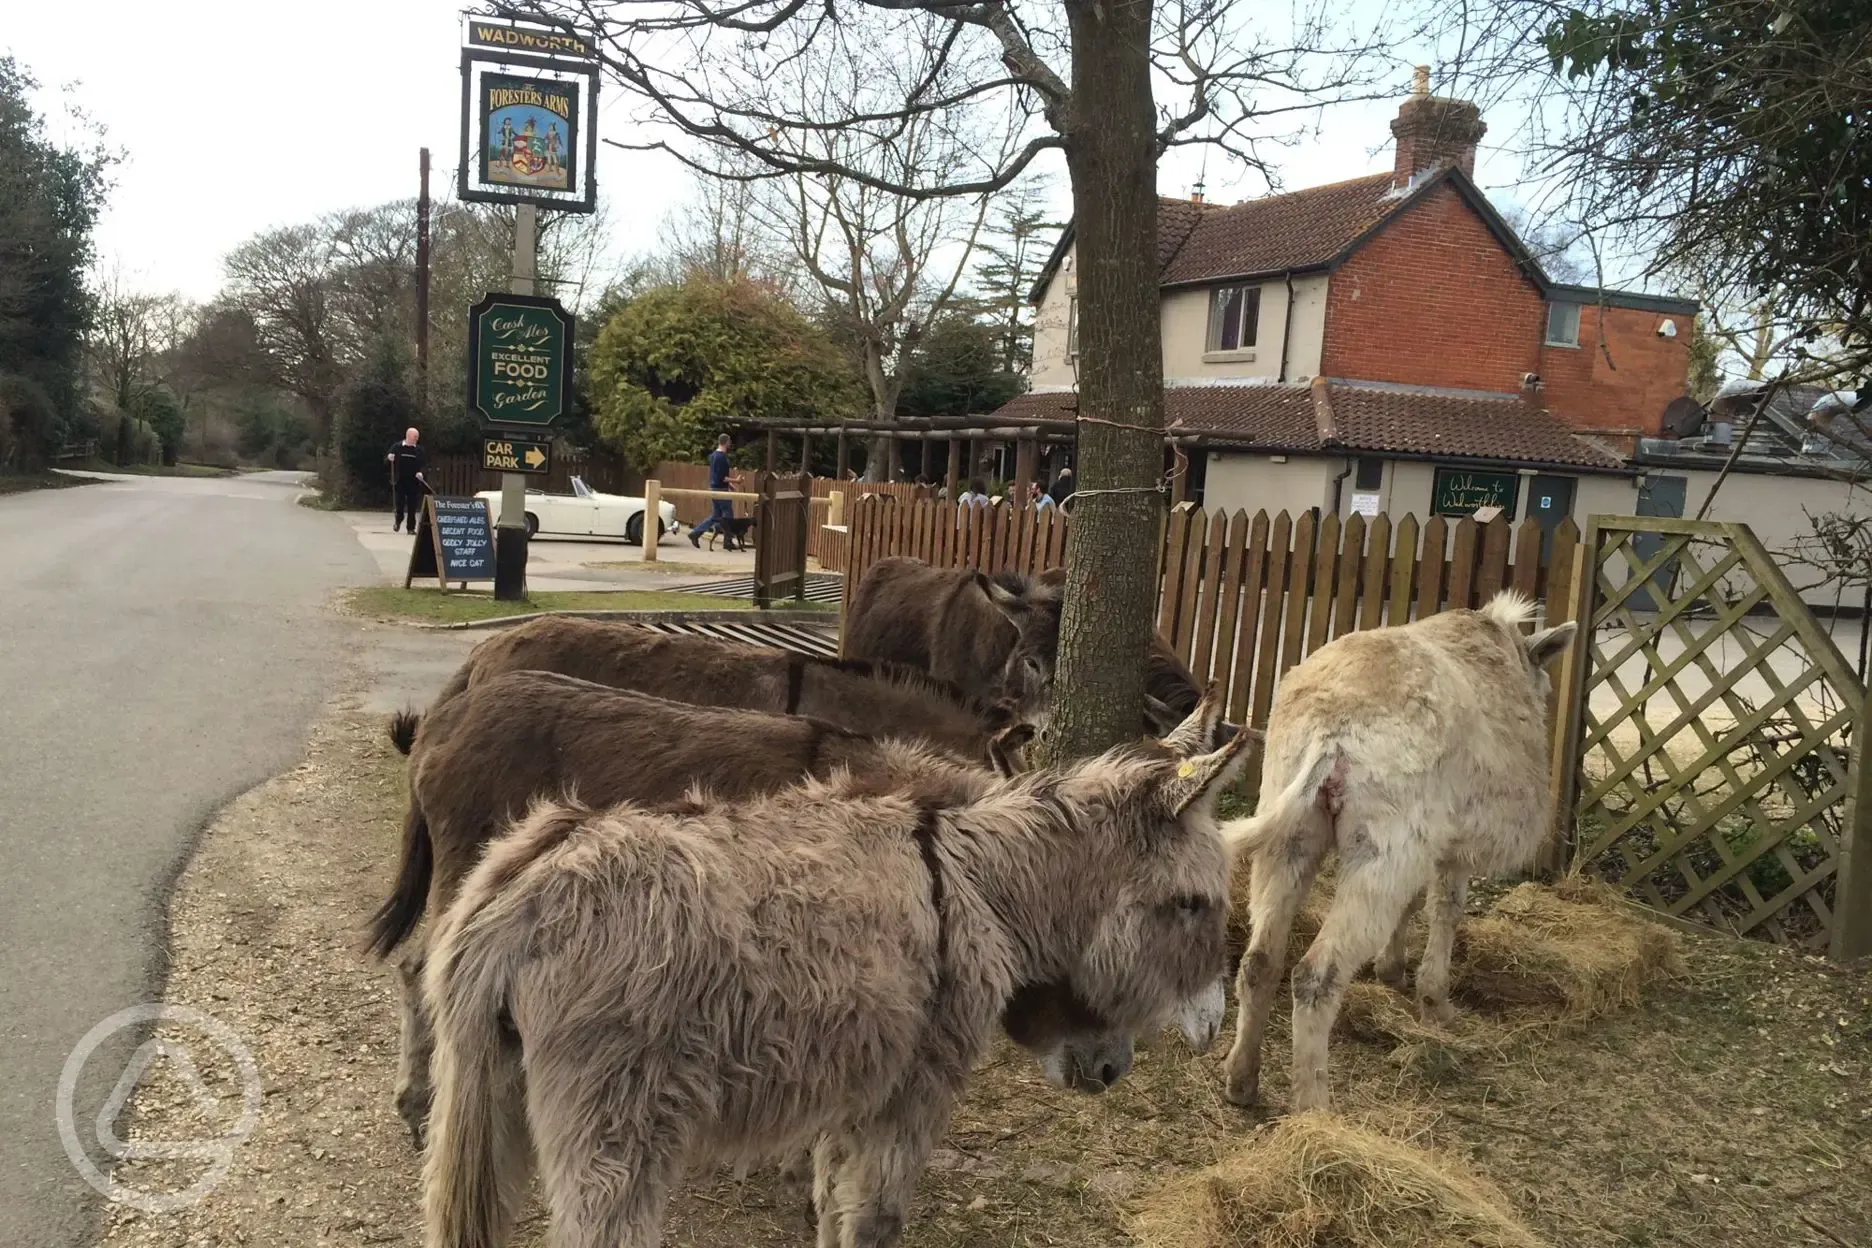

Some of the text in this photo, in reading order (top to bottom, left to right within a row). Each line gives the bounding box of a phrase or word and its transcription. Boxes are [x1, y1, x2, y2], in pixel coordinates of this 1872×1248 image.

[489, 88, 569, 119] FORESTERS ARMS
[492, 314, 549, 339] Cask Ales
[491, 352, 551, 364] EXCELLENT
[494, 362, 548, 379] FOOD
[493, 387, 548, 408] Garden
[486, 442, 513, 455] CAR
[486, 455, 519, 469] PARK
[1450, 474, 1488, 492] Welcome
[467, 528, 484, 536] FOOD
[465, 539, 487, 547] JOLLY
[450, 559, 484, 567] NICE CAT
